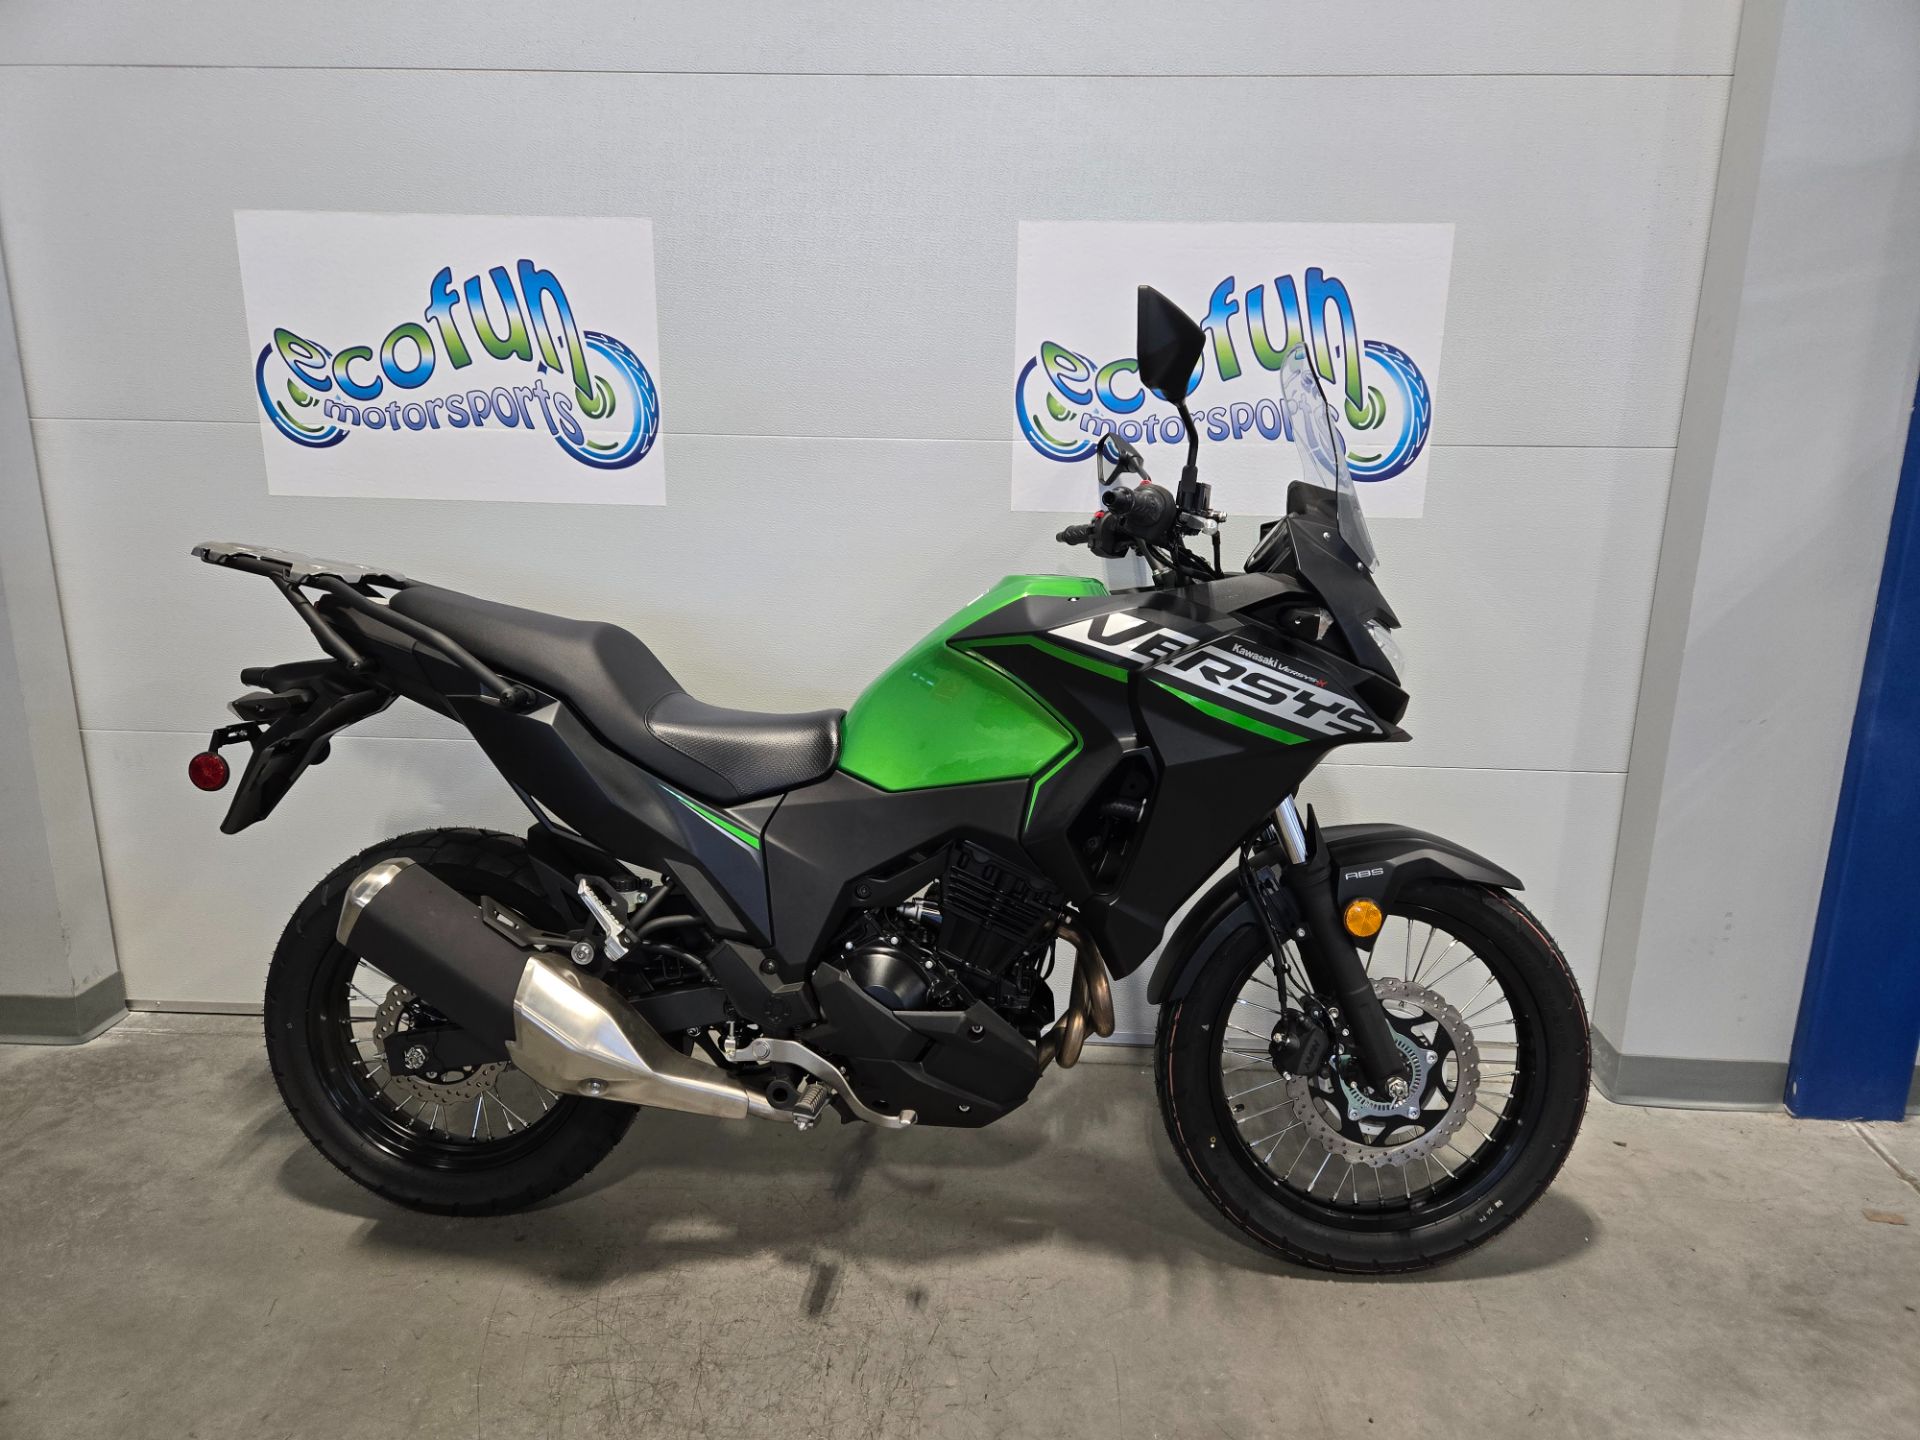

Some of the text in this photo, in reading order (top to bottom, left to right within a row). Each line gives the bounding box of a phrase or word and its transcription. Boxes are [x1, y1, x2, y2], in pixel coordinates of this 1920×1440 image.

[1041, 267, 1364, 411] ecfun
[323, 379, 584, 445] motorsports
[1086, 611, 1379, 734] VERSYS
[1232, 643, 1279, 667] Kawasaki
[1345, 867, 1384, 880] ABS
